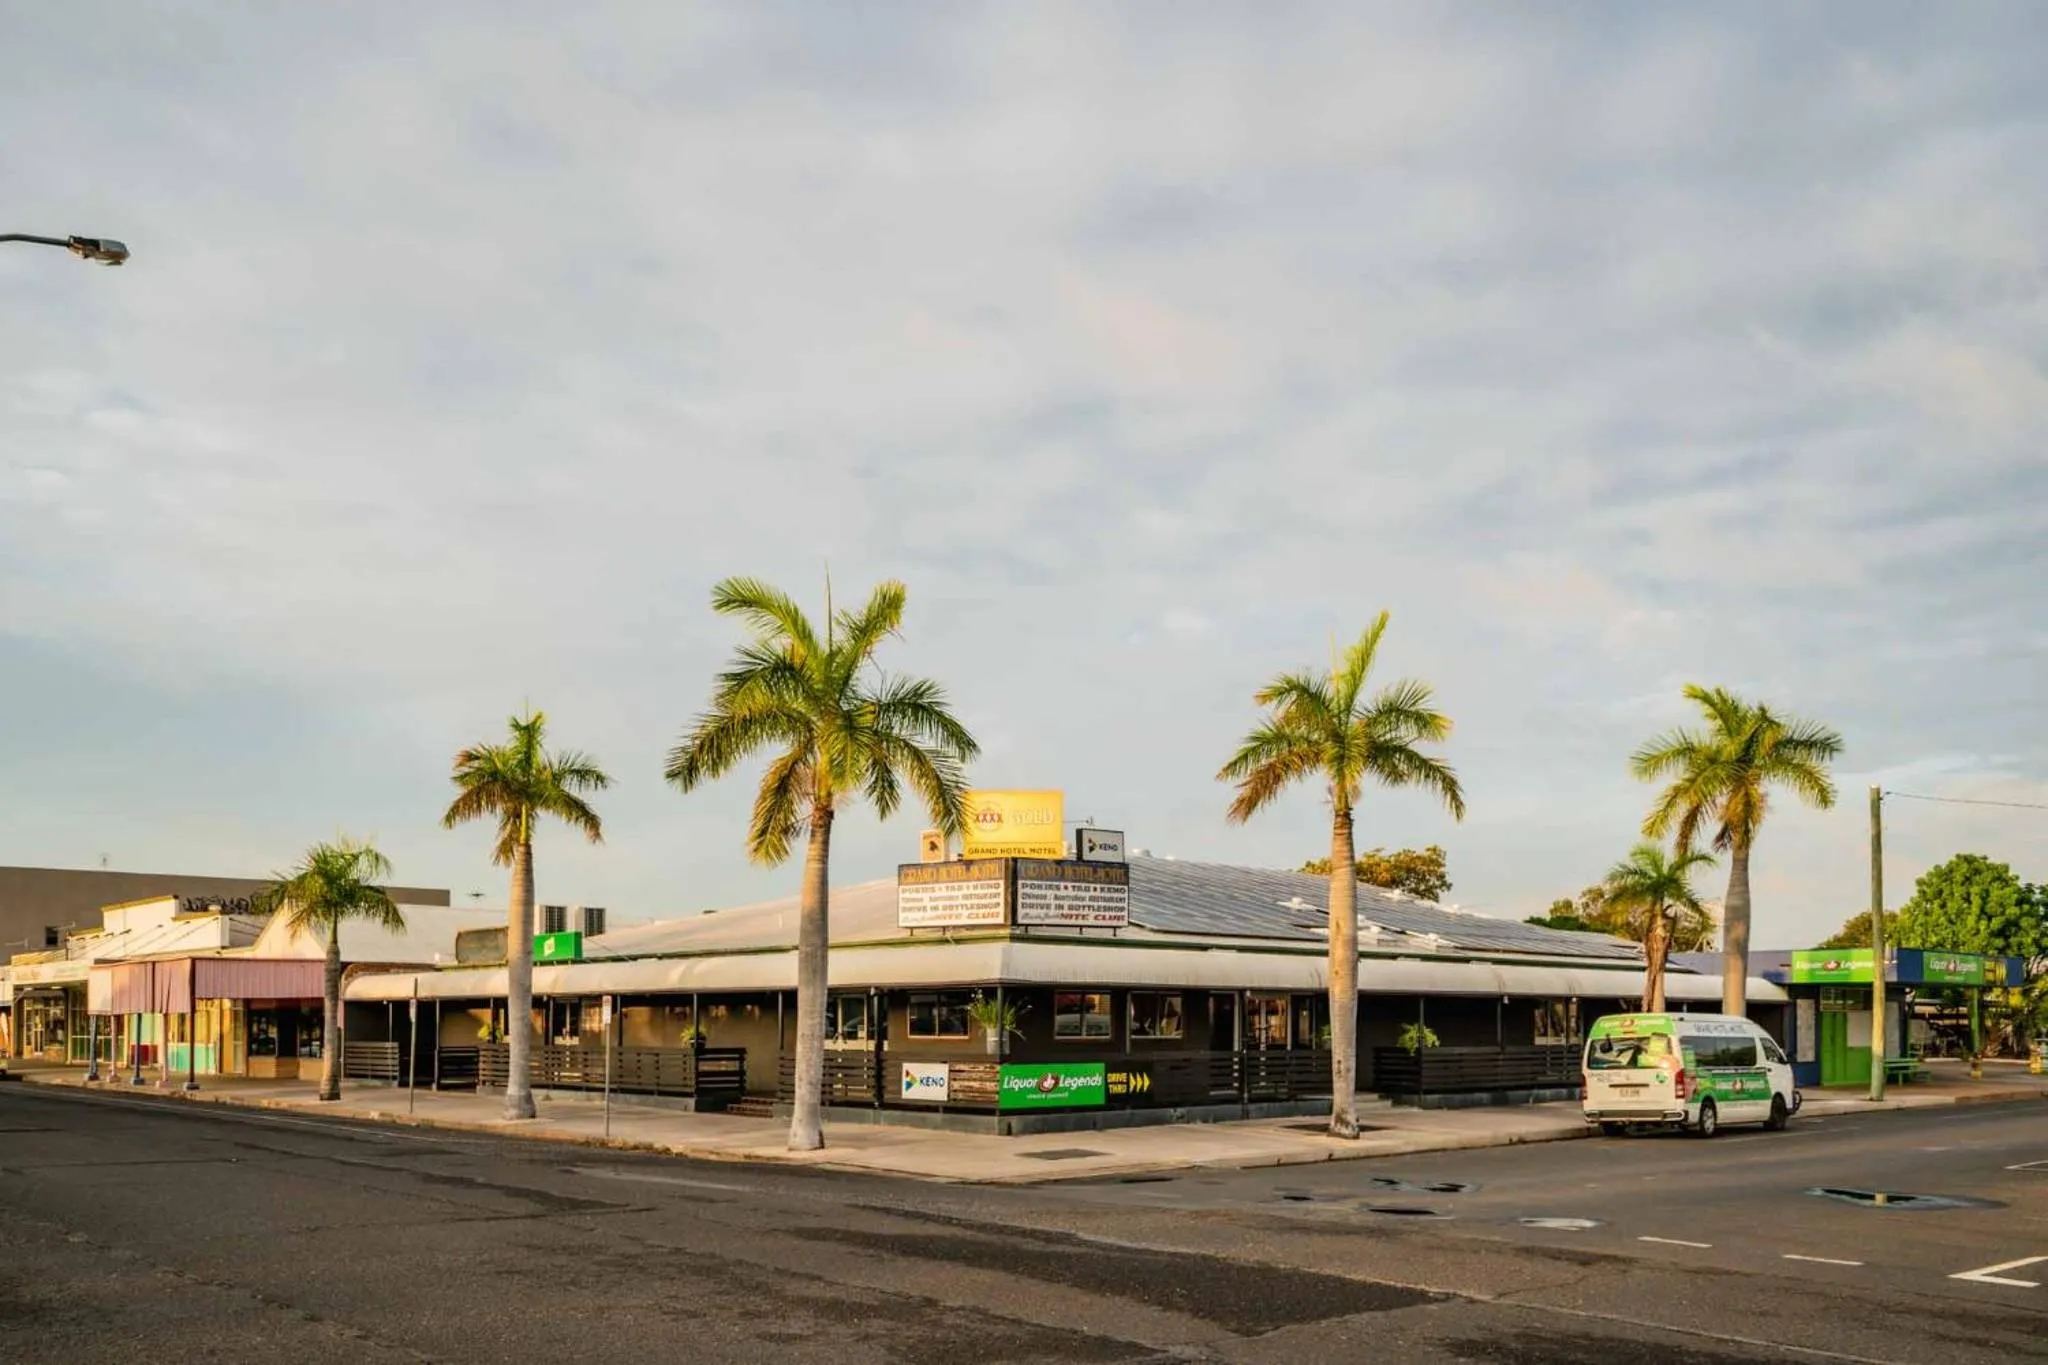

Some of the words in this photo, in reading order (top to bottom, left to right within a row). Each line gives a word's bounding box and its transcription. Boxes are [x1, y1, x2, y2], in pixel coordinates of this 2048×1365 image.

[974, 813, 1003, 823] XXXX
[1011, 808, 1055, 825] GOLD
[968, 847, 998, 855] GRAND
[1000, 847, 1026, 855] HOTEL
[1030, 847, 1056, 855] MOTEL
[972, 882, 1000, 890] KENO
[1021, 882, 1061, 892] POKIES
[1071, 884, 1091, 893] TAB
[1099, 886, 1126, 894] KENO
[942, 902, 1000, 911] BOTTLESHOP
[1021, 902, 1052, 910] DRIVE
[1055, 903, 1064, 911] IN
[1067, 904, 1126, 913] BOTTLESHOP
[1094, 914, 1126, 922] CLUB
[919, 1075, 945, 1087] KENO
[1003, 1075, 1038, 1091] Liquor
[1060, 1074, 1103, 1090] Legends
[1107, 1072, 1127, 1082] DRIVE
[1108, 1083, 1127, 1094] THRU
